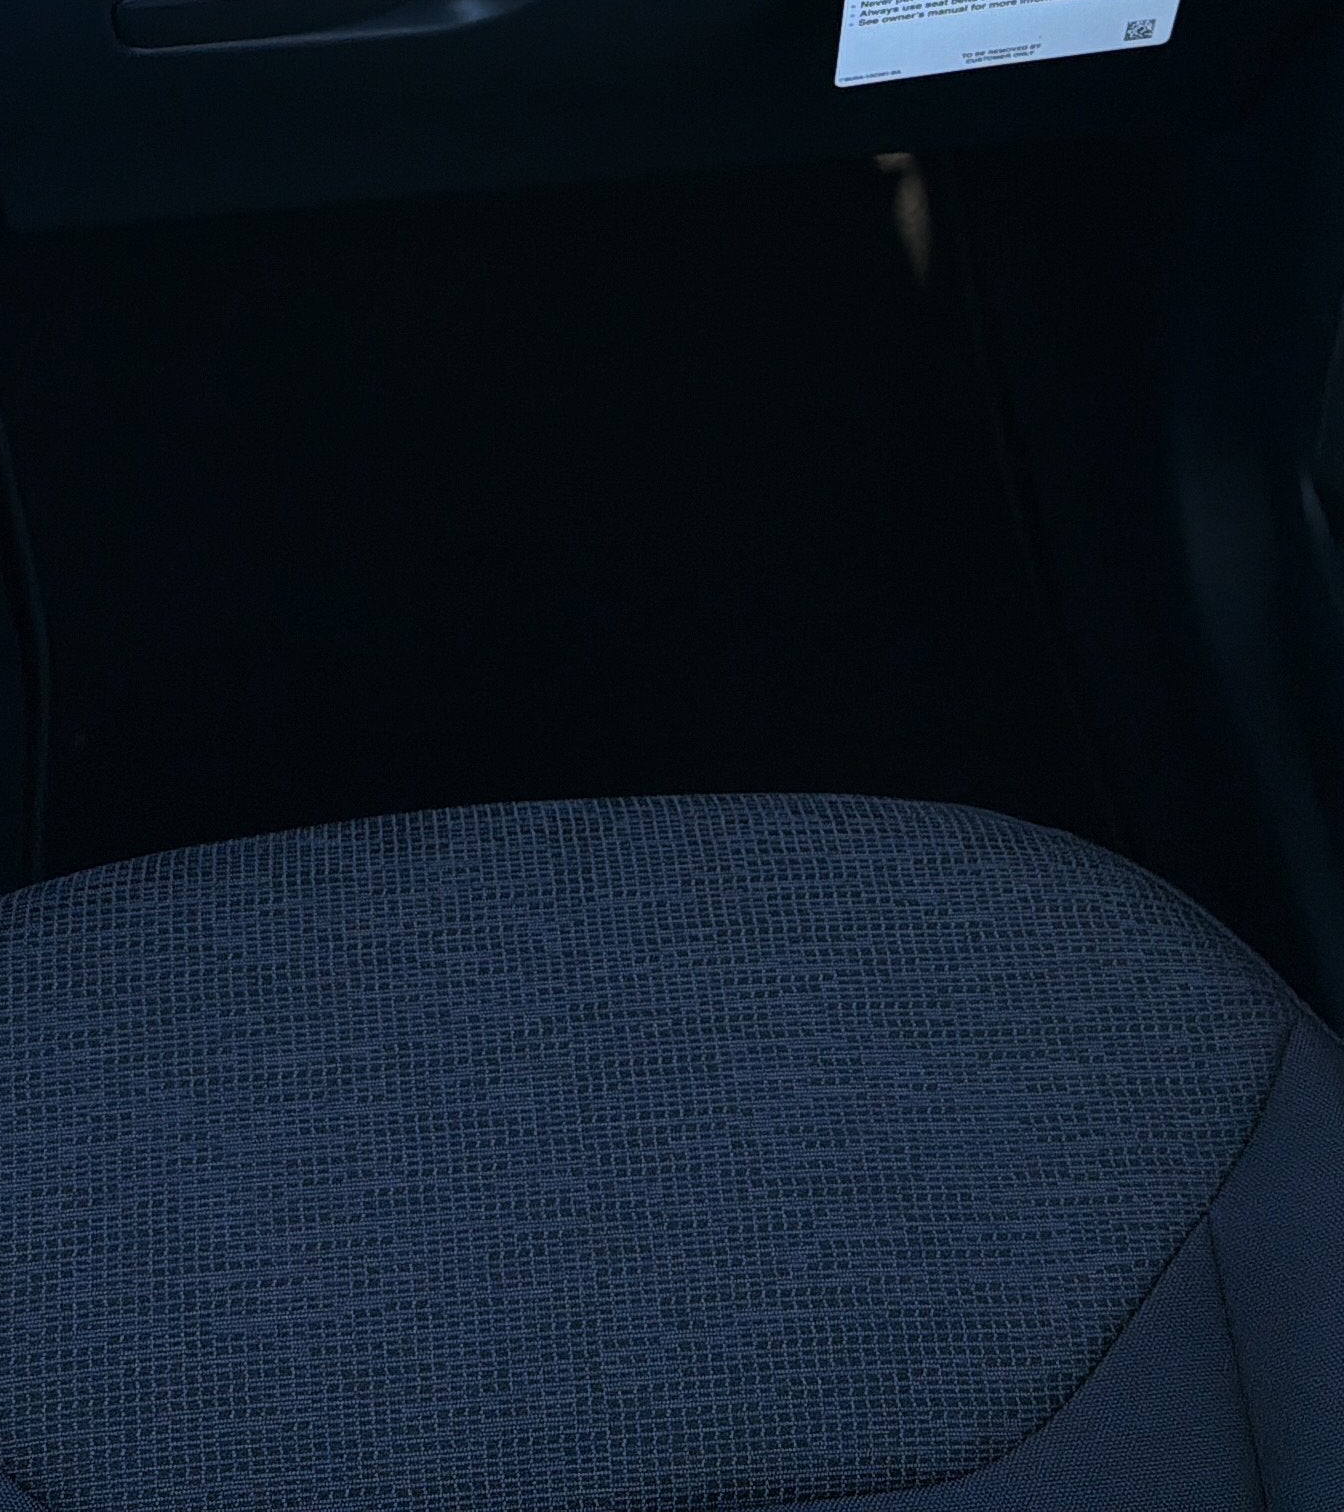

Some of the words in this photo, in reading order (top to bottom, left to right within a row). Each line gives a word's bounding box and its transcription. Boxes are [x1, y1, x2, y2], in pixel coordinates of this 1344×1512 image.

[858, 18, 879, 27] See
[881, 11, 925, 24] owner's
[927, 6, 968, 17] manual
[970, 3, 986, 12] for
[988, 0, 1017, 9] more
[859, 6, 899, 18] Always
[902, 3, 923, 11] use
[925, 0, 948, 8] seat
